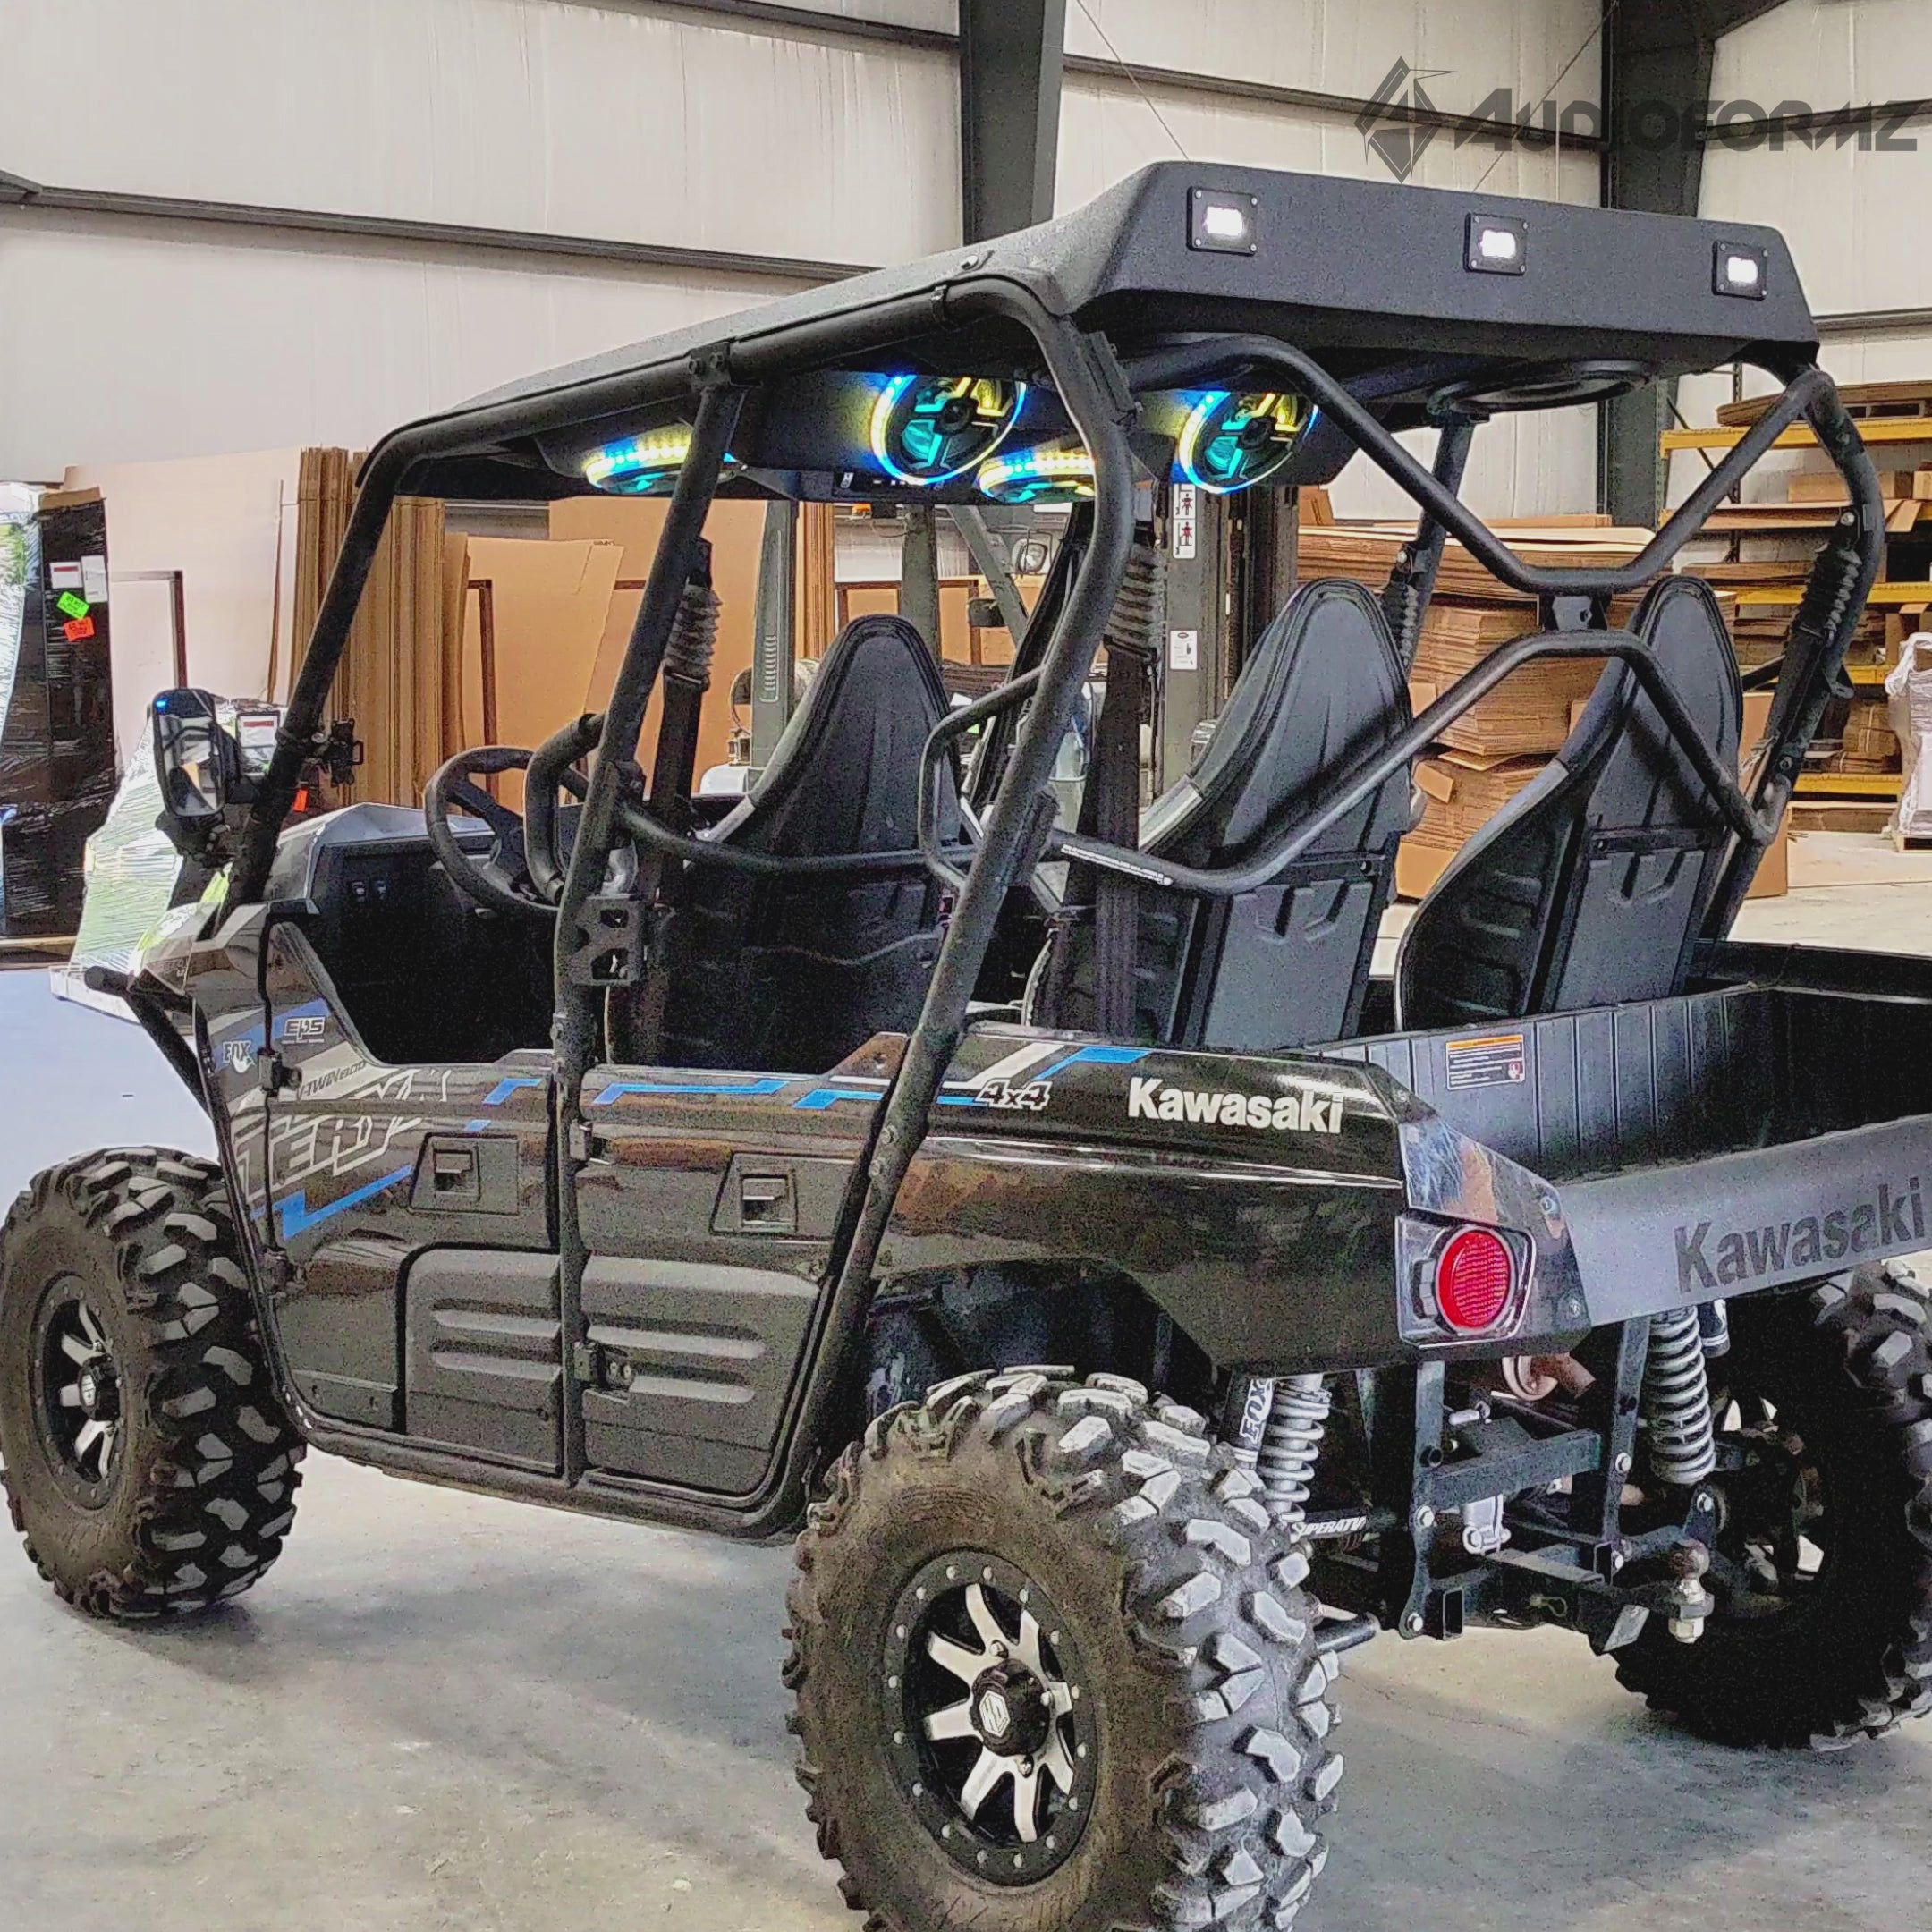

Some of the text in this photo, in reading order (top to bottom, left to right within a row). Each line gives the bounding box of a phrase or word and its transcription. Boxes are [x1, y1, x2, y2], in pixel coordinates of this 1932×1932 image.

[286, 1018, 325, 1038] EPS
[223, 1040, 253, 1069] FOX
[975, 1079, 1052, 1110] 4x4
[1128, 1077, 1342, 1134] Kawasaki
[1674, 1177, 1925, 1294] Kawasaki
